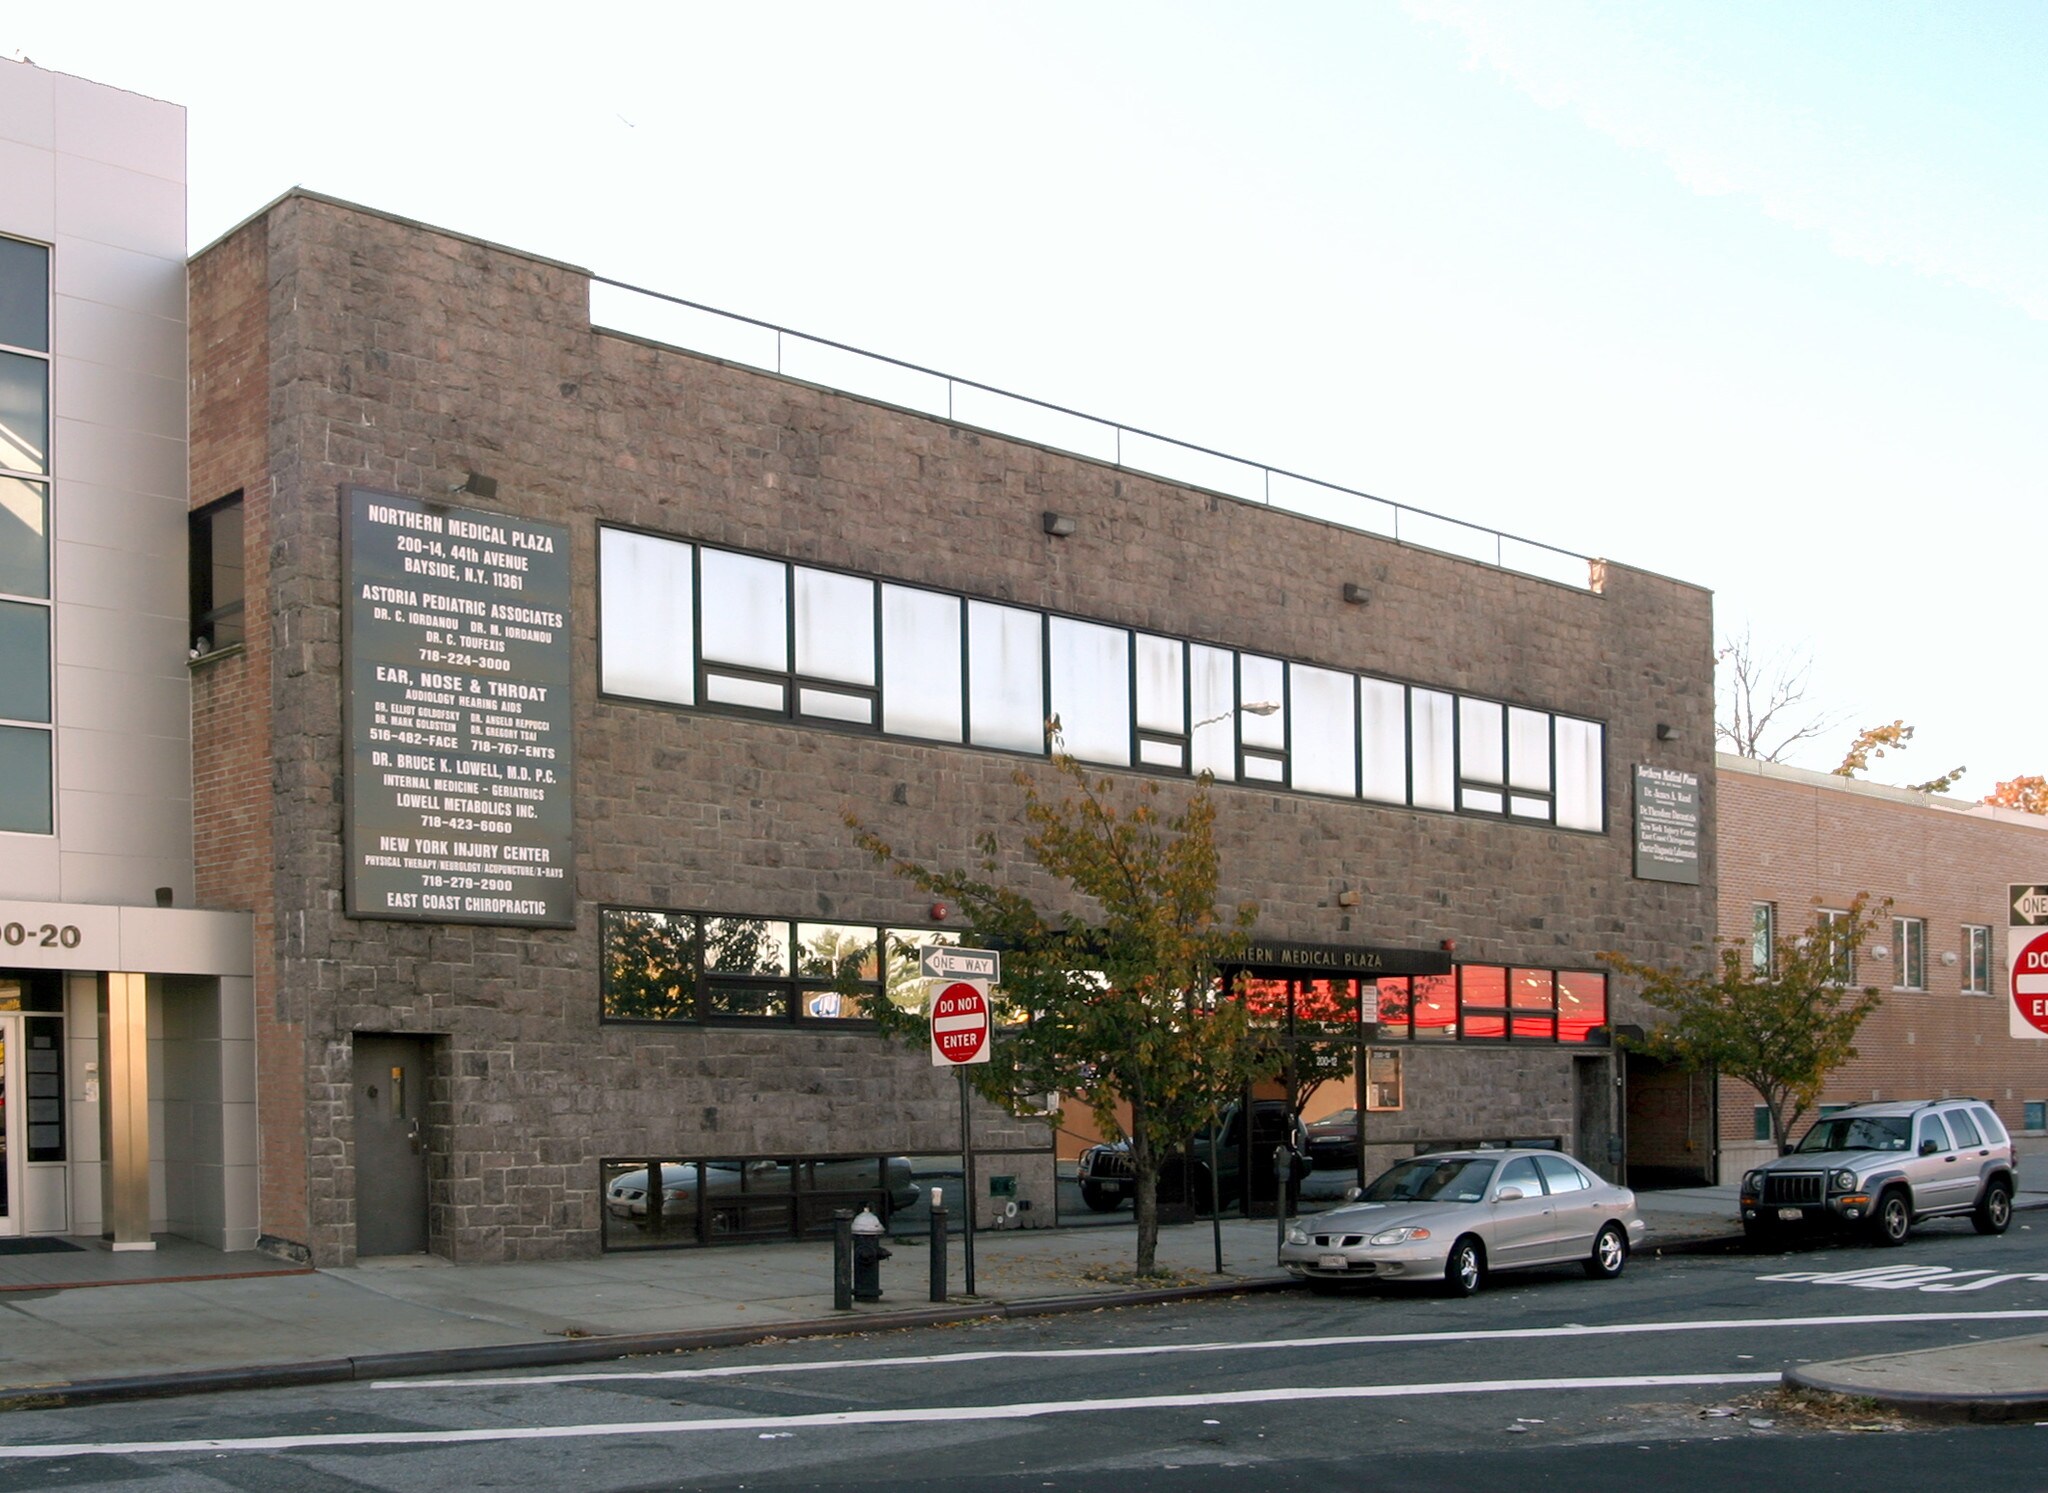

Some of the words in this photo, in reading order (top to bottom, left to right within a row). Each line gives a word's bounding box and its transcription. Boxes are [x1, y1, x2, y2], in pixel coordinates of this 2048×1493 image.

[369, 505, 442, 533] NORTHERN
[449, 520, 506, 545] MEDICAL
[512, 531, 553, 553] PLAZA
[397, 536, 446, 558] 200-14,
[451, 545, 478, 562] 44th
[484, 551, 528, 571] AVENUE
[405, 557, 459, 581] BAYSIDE,
[465, 568, 488, 584] N.Y.
[493, 572, 522, 590] 11361
[363, 585, 417, 606] ASTORIA
[423, 594, 486, 616] PEDIATRIC
[491, 605, 563, 628] ASSOCIATES
[374, 608, 391, 620] DR.
[395, 611, 405, 622] C.
[409, 612, 458, 629] IORDANOU
[426, 631, 442, 644] DR.
[447, 634, 456, 645] C.
[460, 636, 505, 652] TOUFEXIS
[471, 622, 486, 634] DR.
[490, 624, 501, 636] M.
[505, 626, 552, 643] IORDANOU
[419, 649, 510, 671] 718-224-3000
[377, 667, 413, 686] EAR,
[421, 673, 462, 691] NOSE
[470, 679, 481, 693] &
[488, 682, 547, 701] THROAT
[375, 702, 388, 712] DR.
[391, 703, 415, 716] ELLIOT
[406, 689, 455, 705] AUDIOLOGY
[459, 697, 497, 710] HEARING
[501, 703, 522, 713] AIDS
[375, 714, 388, 724] DR.
[391, 716, 413, 727] MARK
[416, 719, 456, 732] GOLDSTEIN
[471, 713, 483, 723] DR.
[370, 729, 458, 749] 516-482-FACE
[471, 725, 483, 735] DR.
[486, 727, 518, 739] GREGORY
[520, 730, 537, 741] TSAI
[471, 740, 555, 759] 718-767-ENTS
[372, 752, 392, 767] DR.
[397, 754, 435, 771] BRUCE
[440, 759, 451, 773] K.
[457, 761, 502, 779] LOWELL,
[507, 766, 531, 781] M.D.
[536, 769, 556, 783] P.C.
[384, 774, 431, 790] INTERNAL
[434, 779, 479, 794] MEDICINE
[492, 785, 544, 800] GERIATRICS
[397, 794, 440, 809] LOWELL
[444, 798, 511, 816] METABOLICS
[516, 805, 538, 818] INC.
[421, 816, 512, 833] 718-423-6060
[380, 837, 409, 852] NEW
[415, 840, 448, 855] YORK
[454, 842, 498, 859] INJURY
[504, 846, 549, 862] CENTER
[365, 855, 401, 867] PHYSICAL
[422, 875, 512, 891] 718-279-2900
[387, 893, 417, 909] EAST
[423, 895, 460, 911] COAST
[465, 899, 546, 915] CHIROPRACTIC
[2023, 898, 2047, 913] ONE
[0, 922, 81, 948] 0-20
[933, 956, 955, 969] ONE
[965, 959, 989, 972] WAY
[1281, 950, 1337, 965] MEDICAL
[1345, 952, 1382, 967] PLAZA
[940, 1000, 954, 1013] DO
[958, 997, 978, 1011] NOT
[944, 1033, 977, 1049] ENTER
